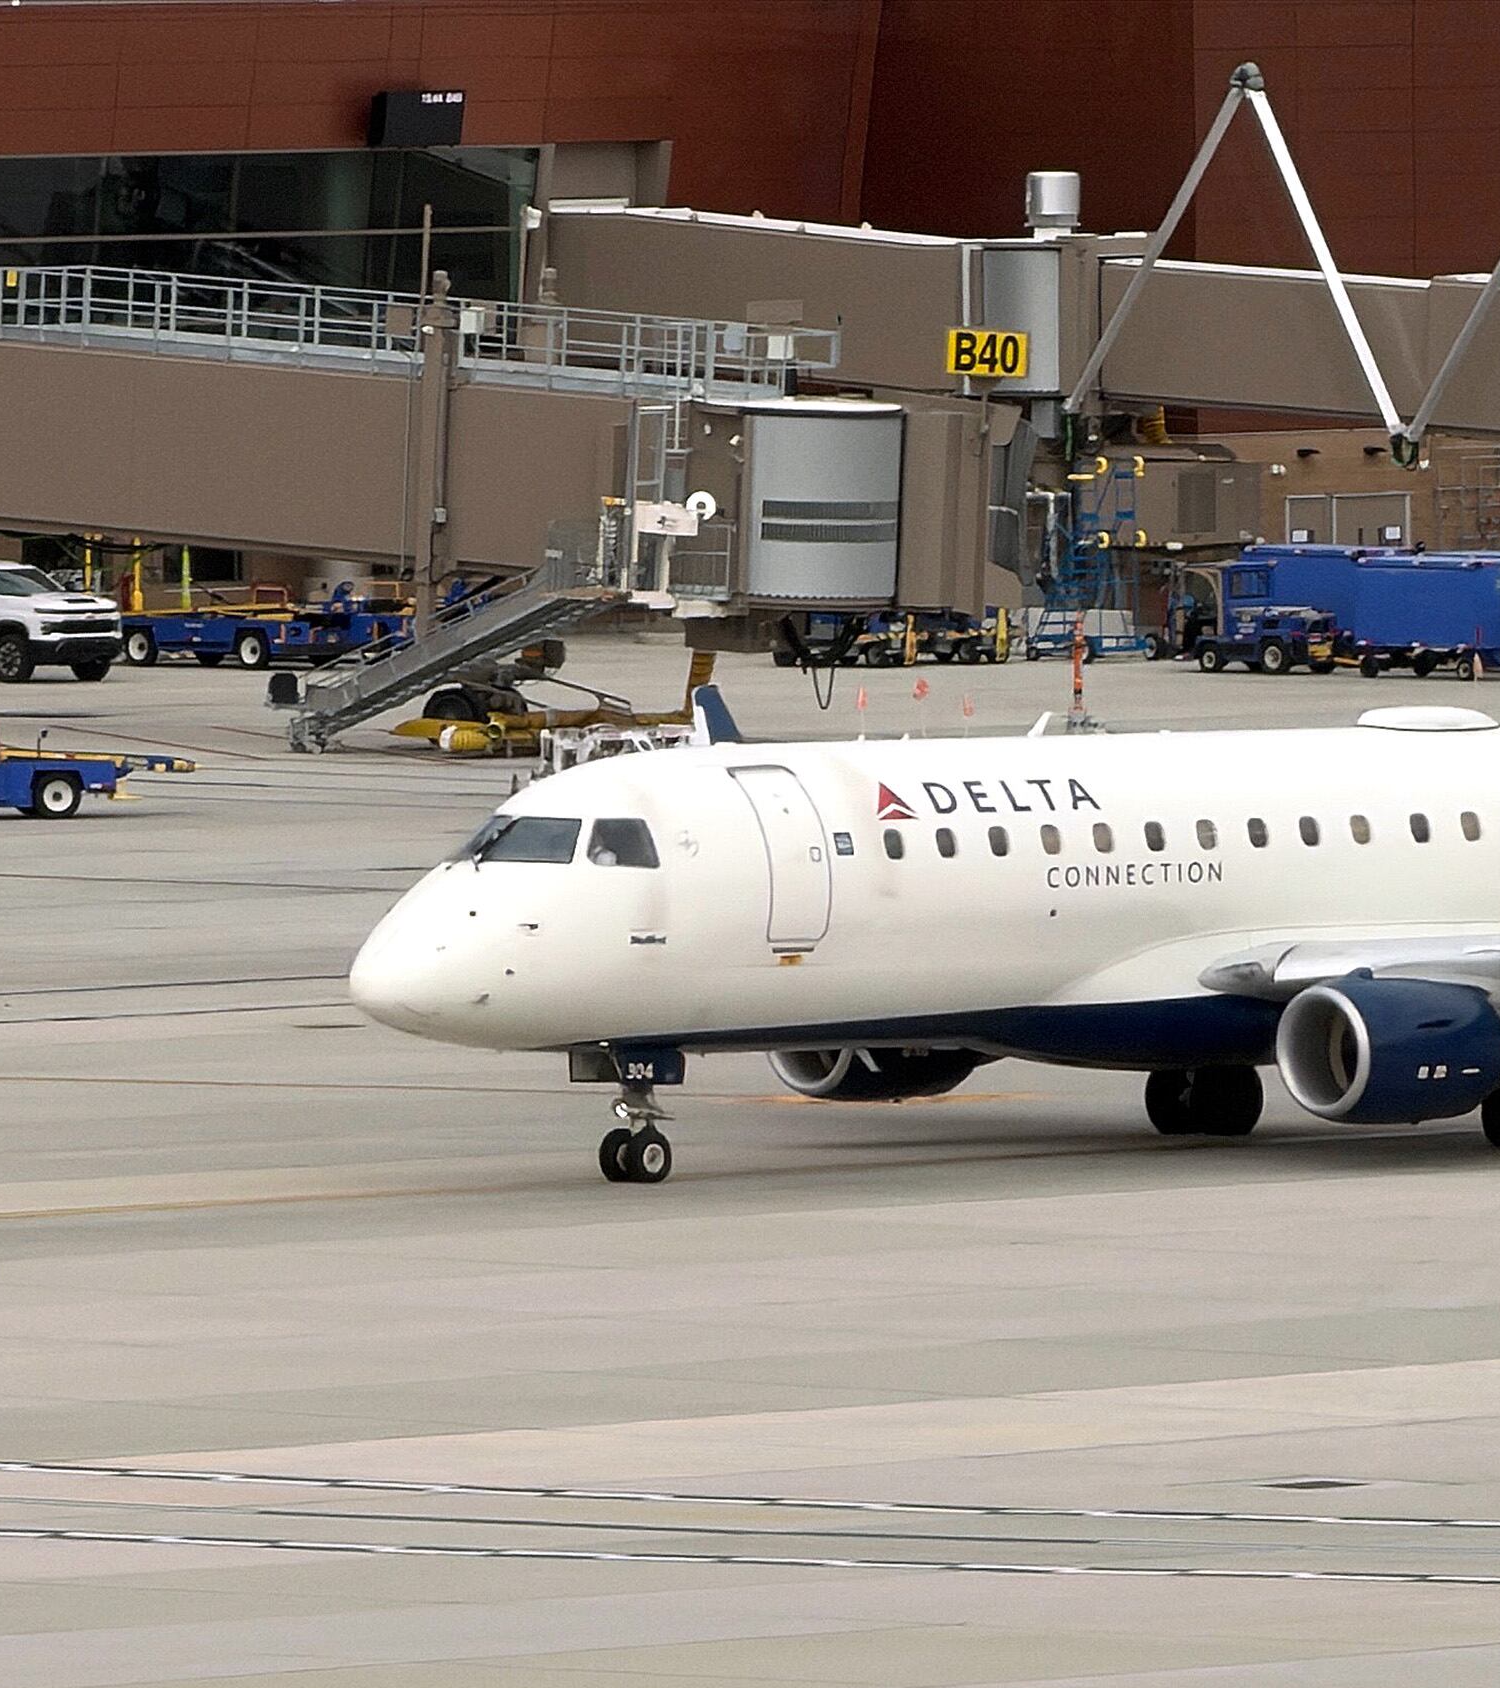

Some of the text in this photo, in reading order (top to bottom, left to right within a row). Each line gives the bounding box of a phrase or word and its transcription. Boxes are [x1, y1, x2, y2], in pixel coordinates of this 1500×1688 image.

[953, 332, 1020, 374] B40
[922, 778, 1101, 814] DELTA
[1047, 861, 1223, 889] CONNECTION
